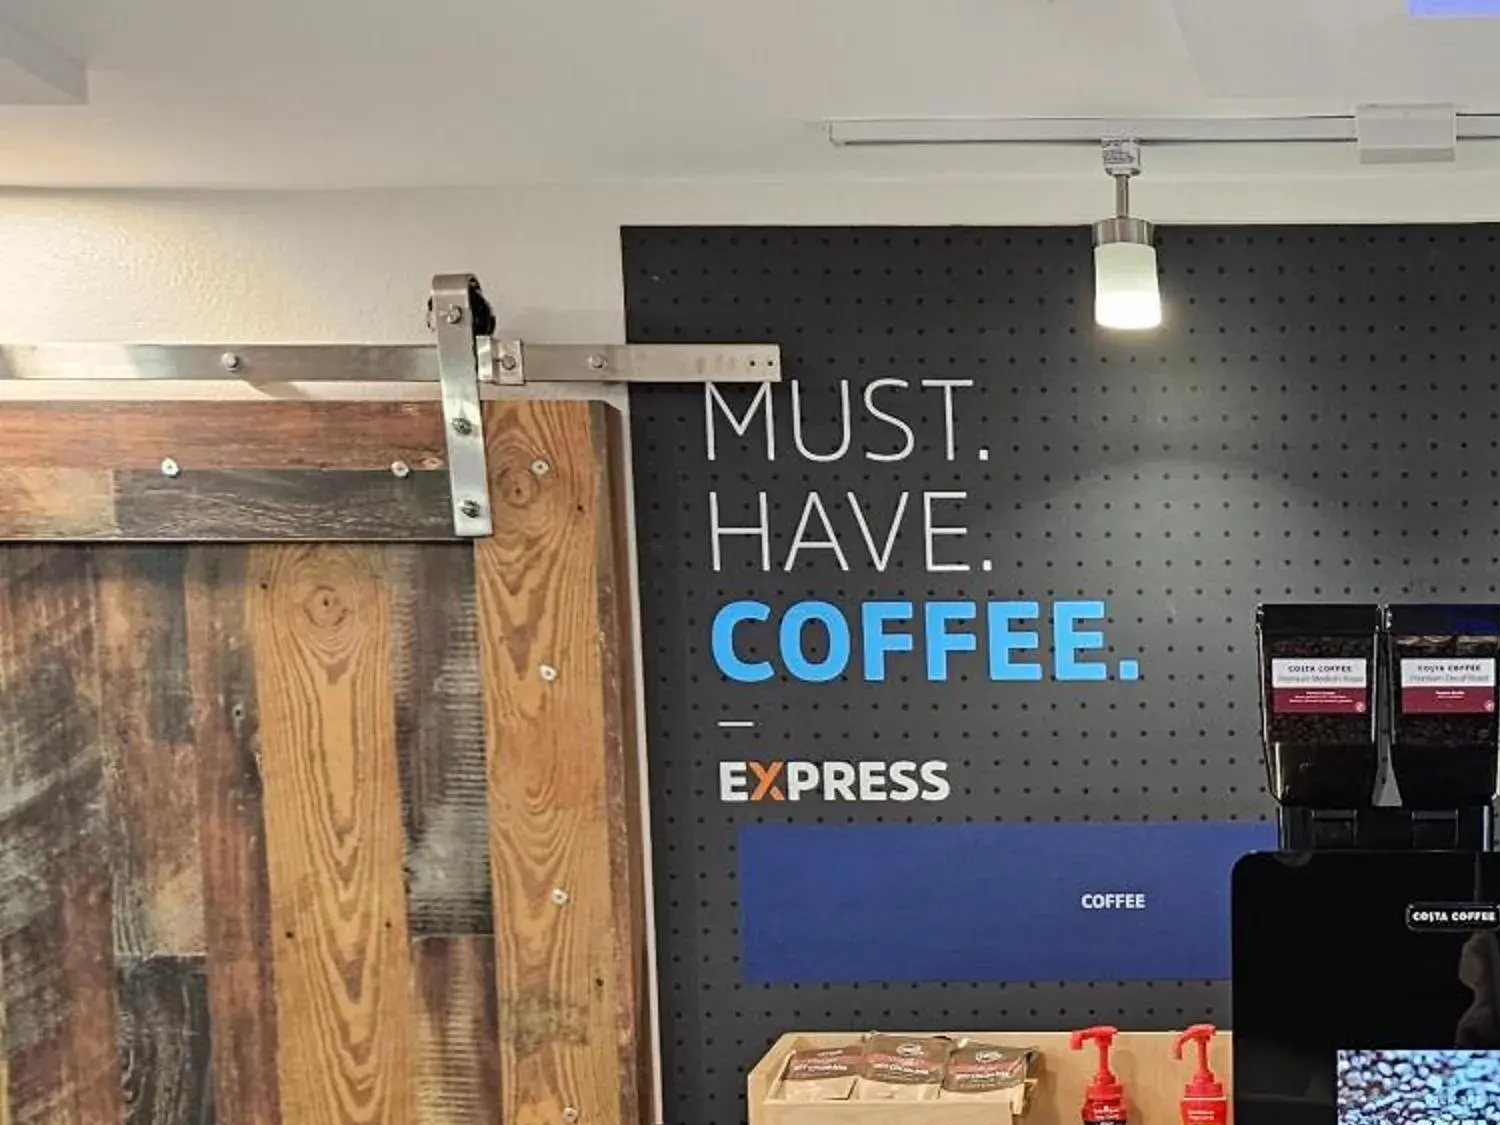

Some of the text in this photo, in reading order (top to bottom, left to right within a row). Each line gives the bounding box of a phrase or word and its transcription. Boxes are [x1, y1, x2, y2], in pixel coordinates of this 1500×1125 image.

[704, 378, 990, 462] MUST.
[708, 490, 993, 572] HAVE.
[710, 600, 1140, 682] COFFEE.
[1288, 665, 1353, 673] COSTA COFFEE
[718, 760, 951, 802] EXPRESS
[1080, 893, 1146, 910] COFFEE
[1411, 911, 1496, 922] COSTA COFFEE
